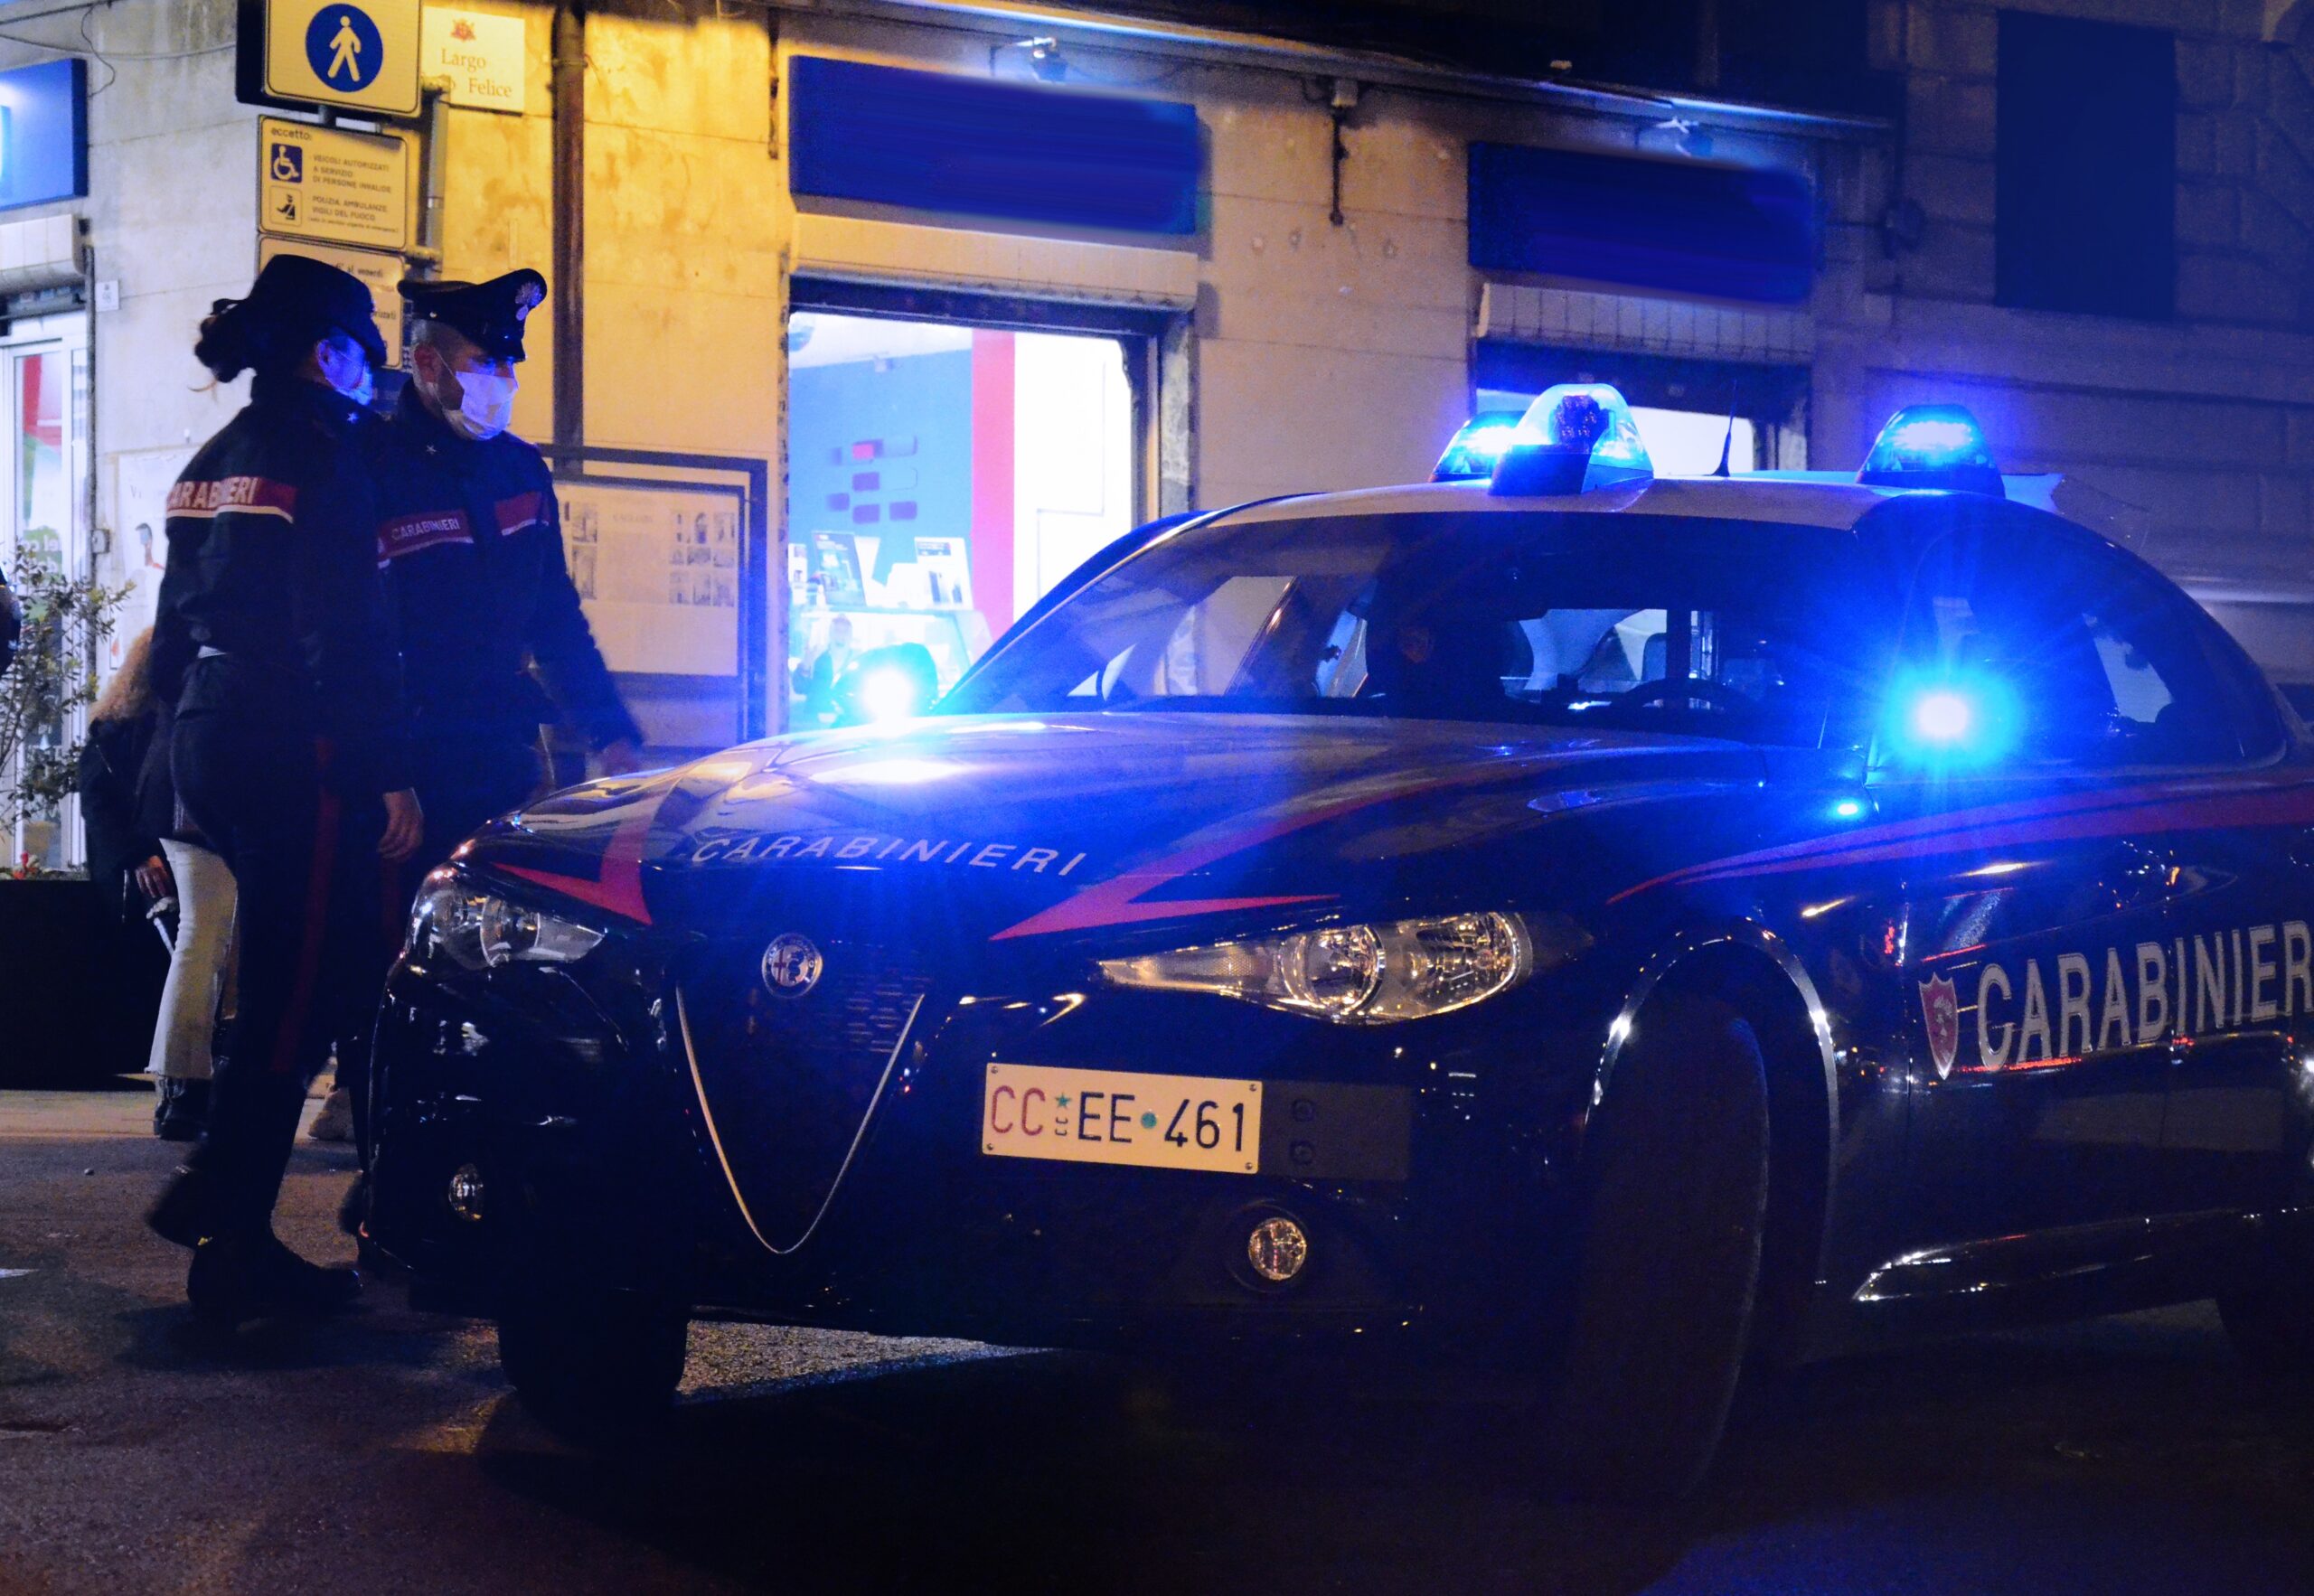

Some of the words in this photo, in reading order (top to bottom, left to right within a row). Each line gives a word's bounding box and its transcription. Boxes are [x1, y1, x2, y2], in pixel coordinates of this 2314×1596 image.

[441, 48, 486, 72] Largo
[468, 78, 513, 98] Felice
[314, 154, 341, 164] VEICOLI
[343, 159, 390, 172] AUTORIZZATI
[320, 166, 353, 177] SERVIZIO
[323, 176, 357, 188] PERSONE
[334, 209, 348, 217] DEL
[351, 211, 376, 221] FUOCO
[343, 200, 388, 212] AMBULANZE
[691, 836, 1087, 876] CARABINIERI
[1977, 920, 2314, 1072] CARABINIER
[991, 1085, 1046, 1136] CC
[1077, 1091, 1135, 1143] EE
[1164, 1098, 1245, 1152] 461
